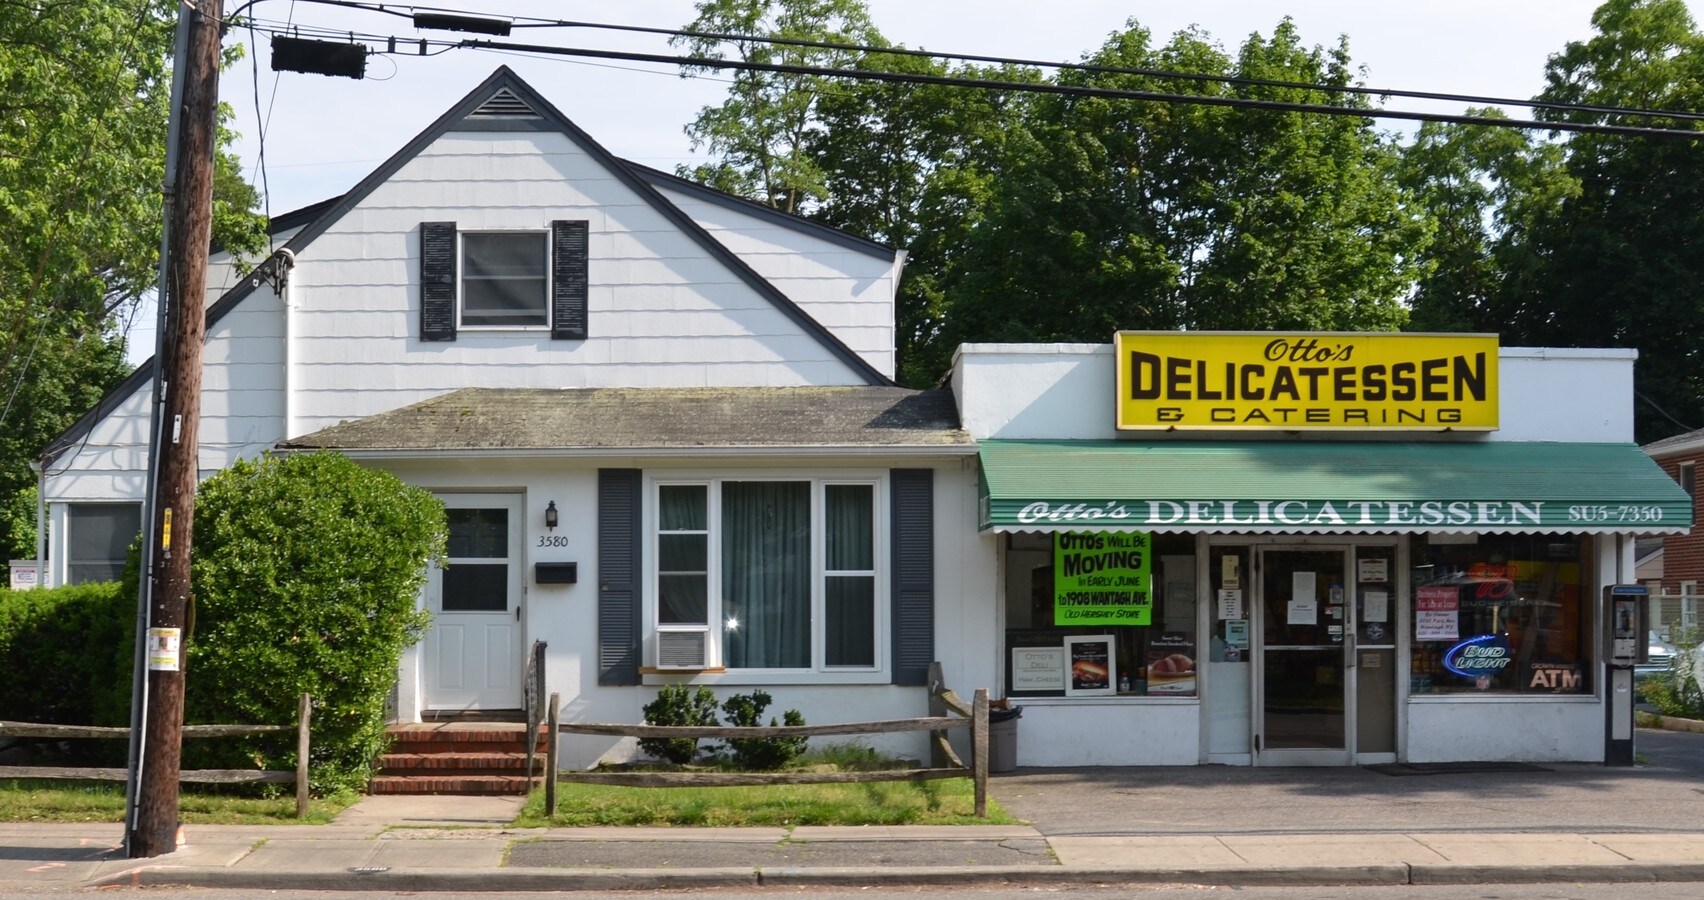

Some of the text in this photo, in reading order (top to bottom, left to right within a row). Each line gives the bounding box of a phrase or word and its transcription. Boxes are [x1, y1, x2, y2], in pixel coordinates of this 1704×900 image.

[1264, 338, 1354, 363] Otto's
[1131, 350, 1486, 402] DELICATESSEN
[1157, 407, 1461, 423] & CATERING
[1016, 500, 1663, 525] Otto's DELICATESSEN SU5-7350
[536, 535, 569, 548] 3580
[1064, 551, 1142, 577] MOVING
[1087, 576, 1114, 587] EARLY
[1114, 576, 1140, 587] JUNE
[1066, 592, 1090, 606] 1908
[1090, 592, 1131, 606] WANTAGH
[1064, 609, 1140, 619] OLD HERSHEY STORE
[1464, 645, 1506, 658] BUD
[1455, 657, 1511, 669] LIGHT
[1529, 669, 1582, 688] ATM
